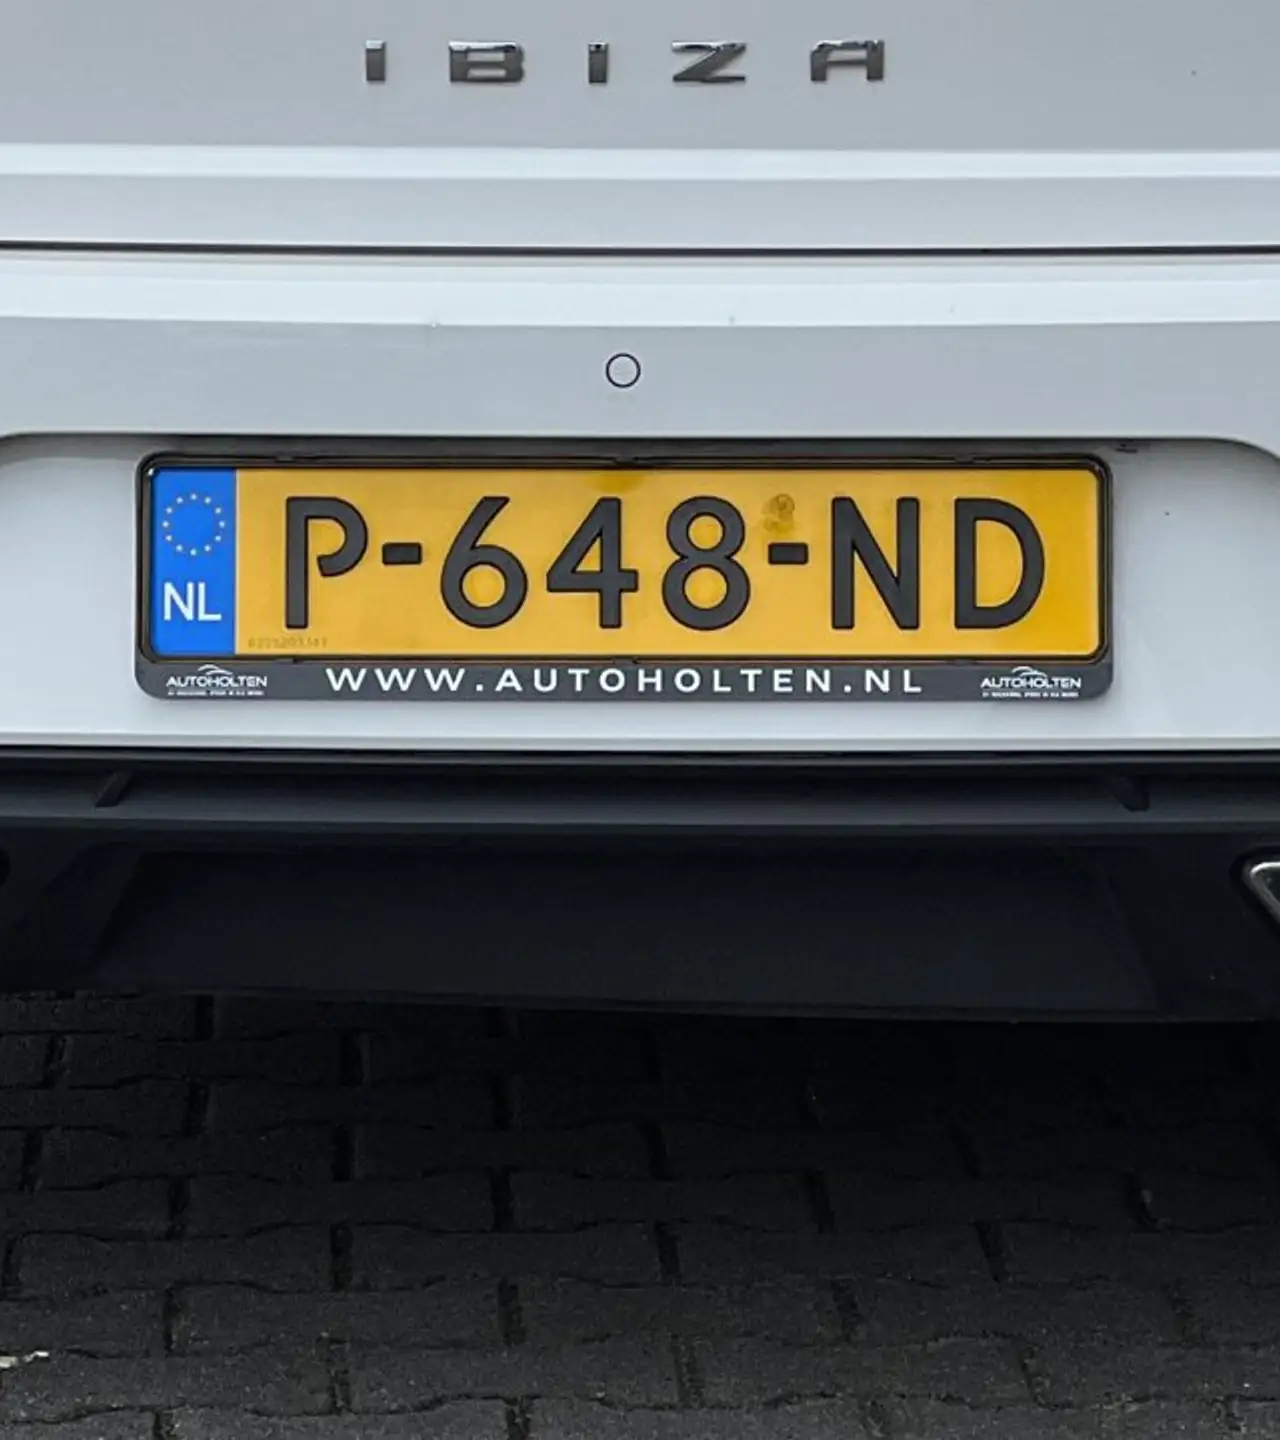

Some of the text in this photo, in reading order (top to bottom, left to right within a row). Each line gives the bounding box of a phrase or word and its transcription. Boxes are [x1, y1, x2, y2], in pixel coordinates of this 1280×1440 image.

[365, 40, 886, 86] IBIZA
[286, 495, 1045, 631] P-648-ND
[163, 581, 222, 621] NL
[166, 675, 268, 688] AUTOHOLTEN
[325, 667, 922, 693] WWW.AUTOHOLTEN.NL
[980, 677, 1082, 689] AUTOHOLTEN
